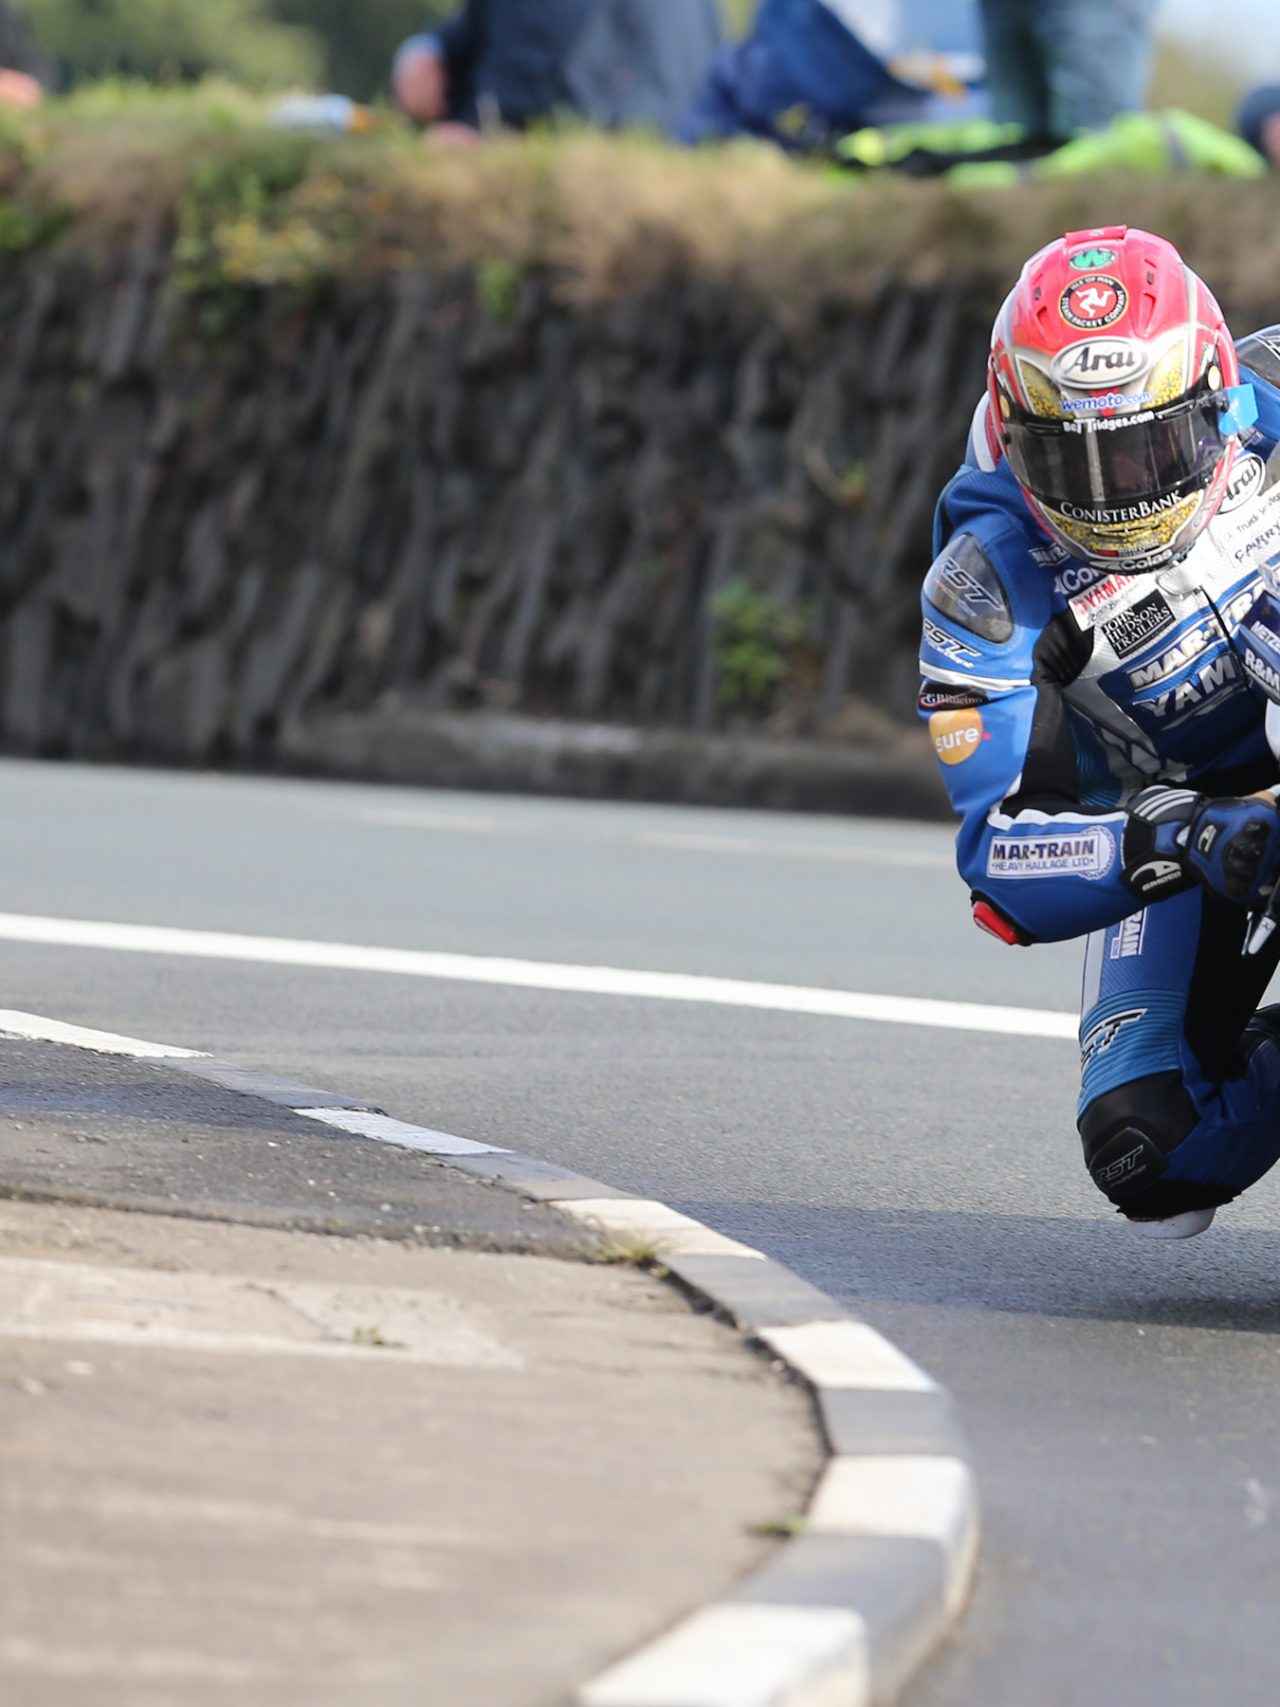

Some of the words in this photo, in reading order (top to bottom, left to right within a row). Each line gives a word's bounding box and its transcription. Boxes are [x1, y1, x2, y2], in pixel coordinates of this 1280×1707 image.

[1071, 347, 1135, 373] Arai
[1060, 390, 1152, 411] wemoto.com
[1120, 550, 1173, 570] Colas
[941, 557, 1006, 612] RST
[1103, 608, 1135, 633] JOHN
[1107, 603, 1158, 643] HUDSON
[1113, 607, 1170, 650] TRAILERS
[993, 838, 1095, 860] MAR-TRAIN
[995, 861, 1023, 871] HEAVY
[1026, 859, 1068, 869] HAULAGE
[1073, 857, 1090, 867] LTD
[1098, 1145, 1144, 1180] RST
